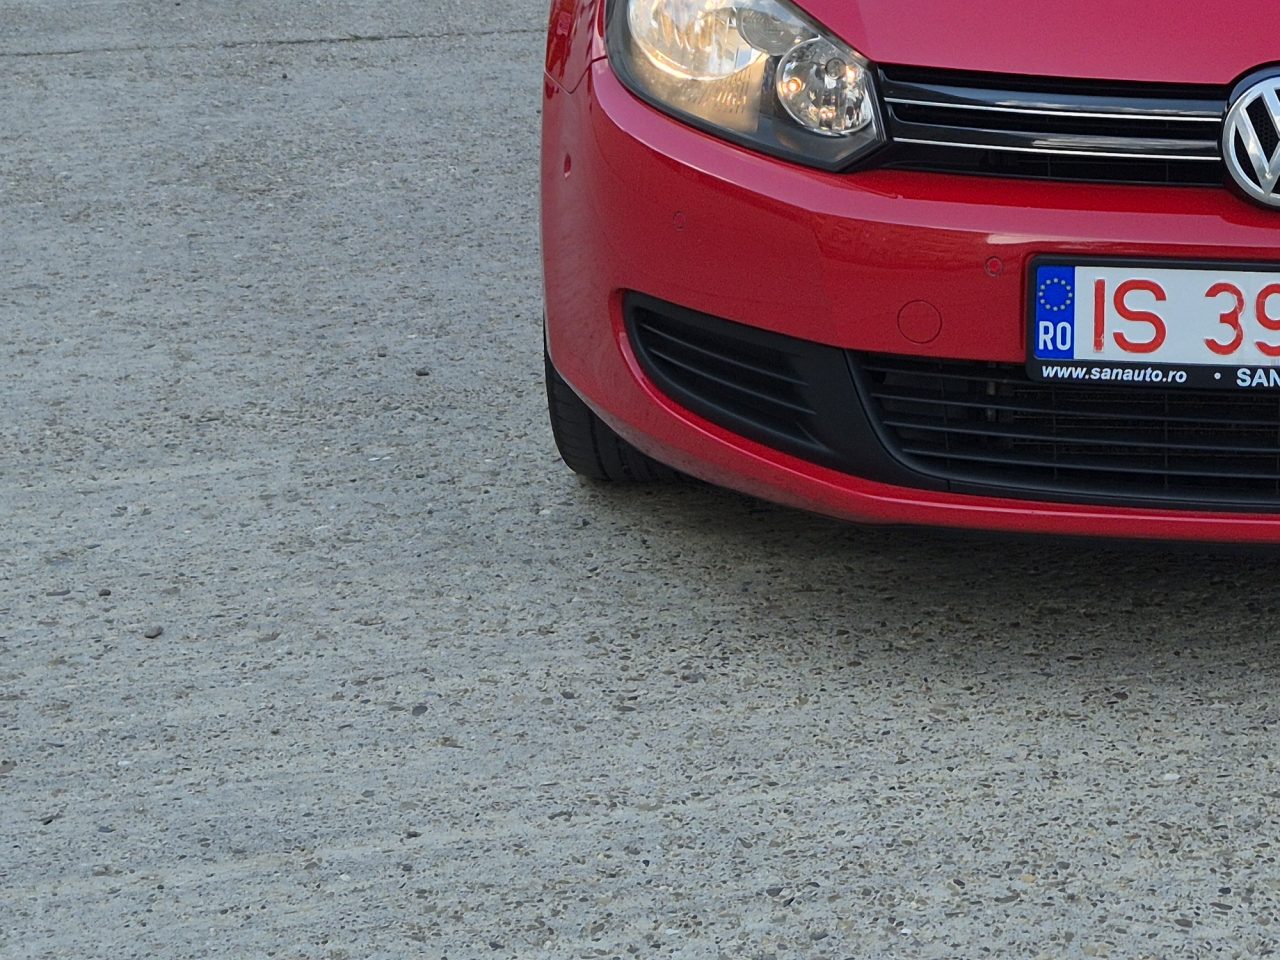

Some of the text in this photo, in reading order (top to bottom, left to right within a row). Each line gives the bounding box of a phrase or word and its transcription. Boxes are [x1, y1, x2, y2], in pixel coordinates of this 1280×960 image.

[1093, 278, 1168, 354] IS
[1038, 321, 1072, 351] RO
[1041, 363, 1188, 384] www.sanauto.ro
